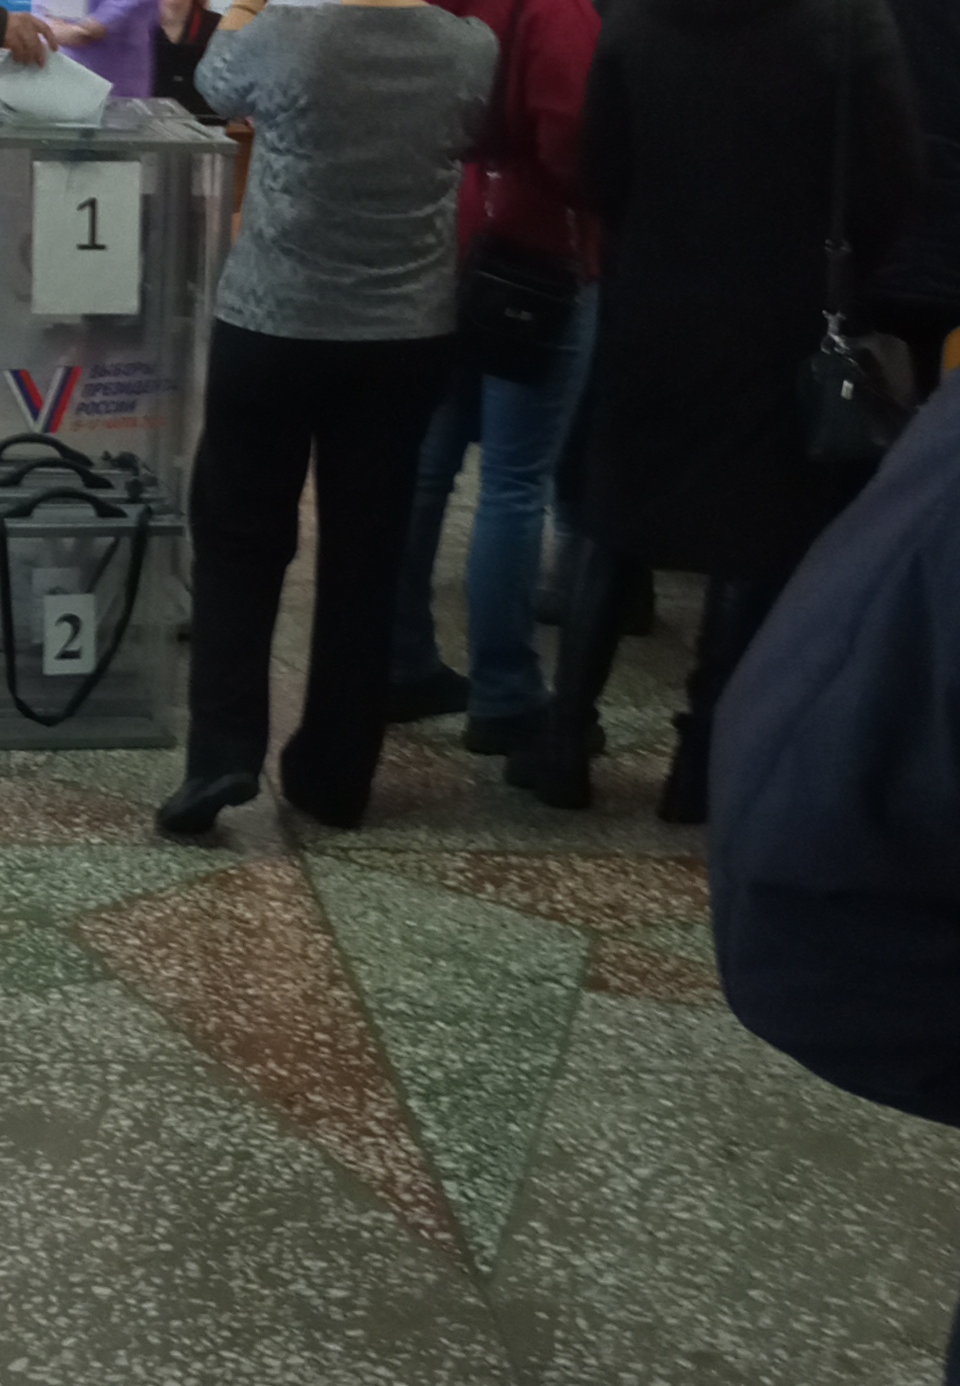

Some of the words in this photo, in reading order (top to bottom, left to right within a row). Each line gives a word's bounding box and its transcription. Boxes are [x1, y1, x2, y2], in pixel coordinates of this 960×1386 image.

[76, 197, 107, 251] 1
[75, 400, 137, 415] РОССИИ
[54, 613, 83, 660] 2
